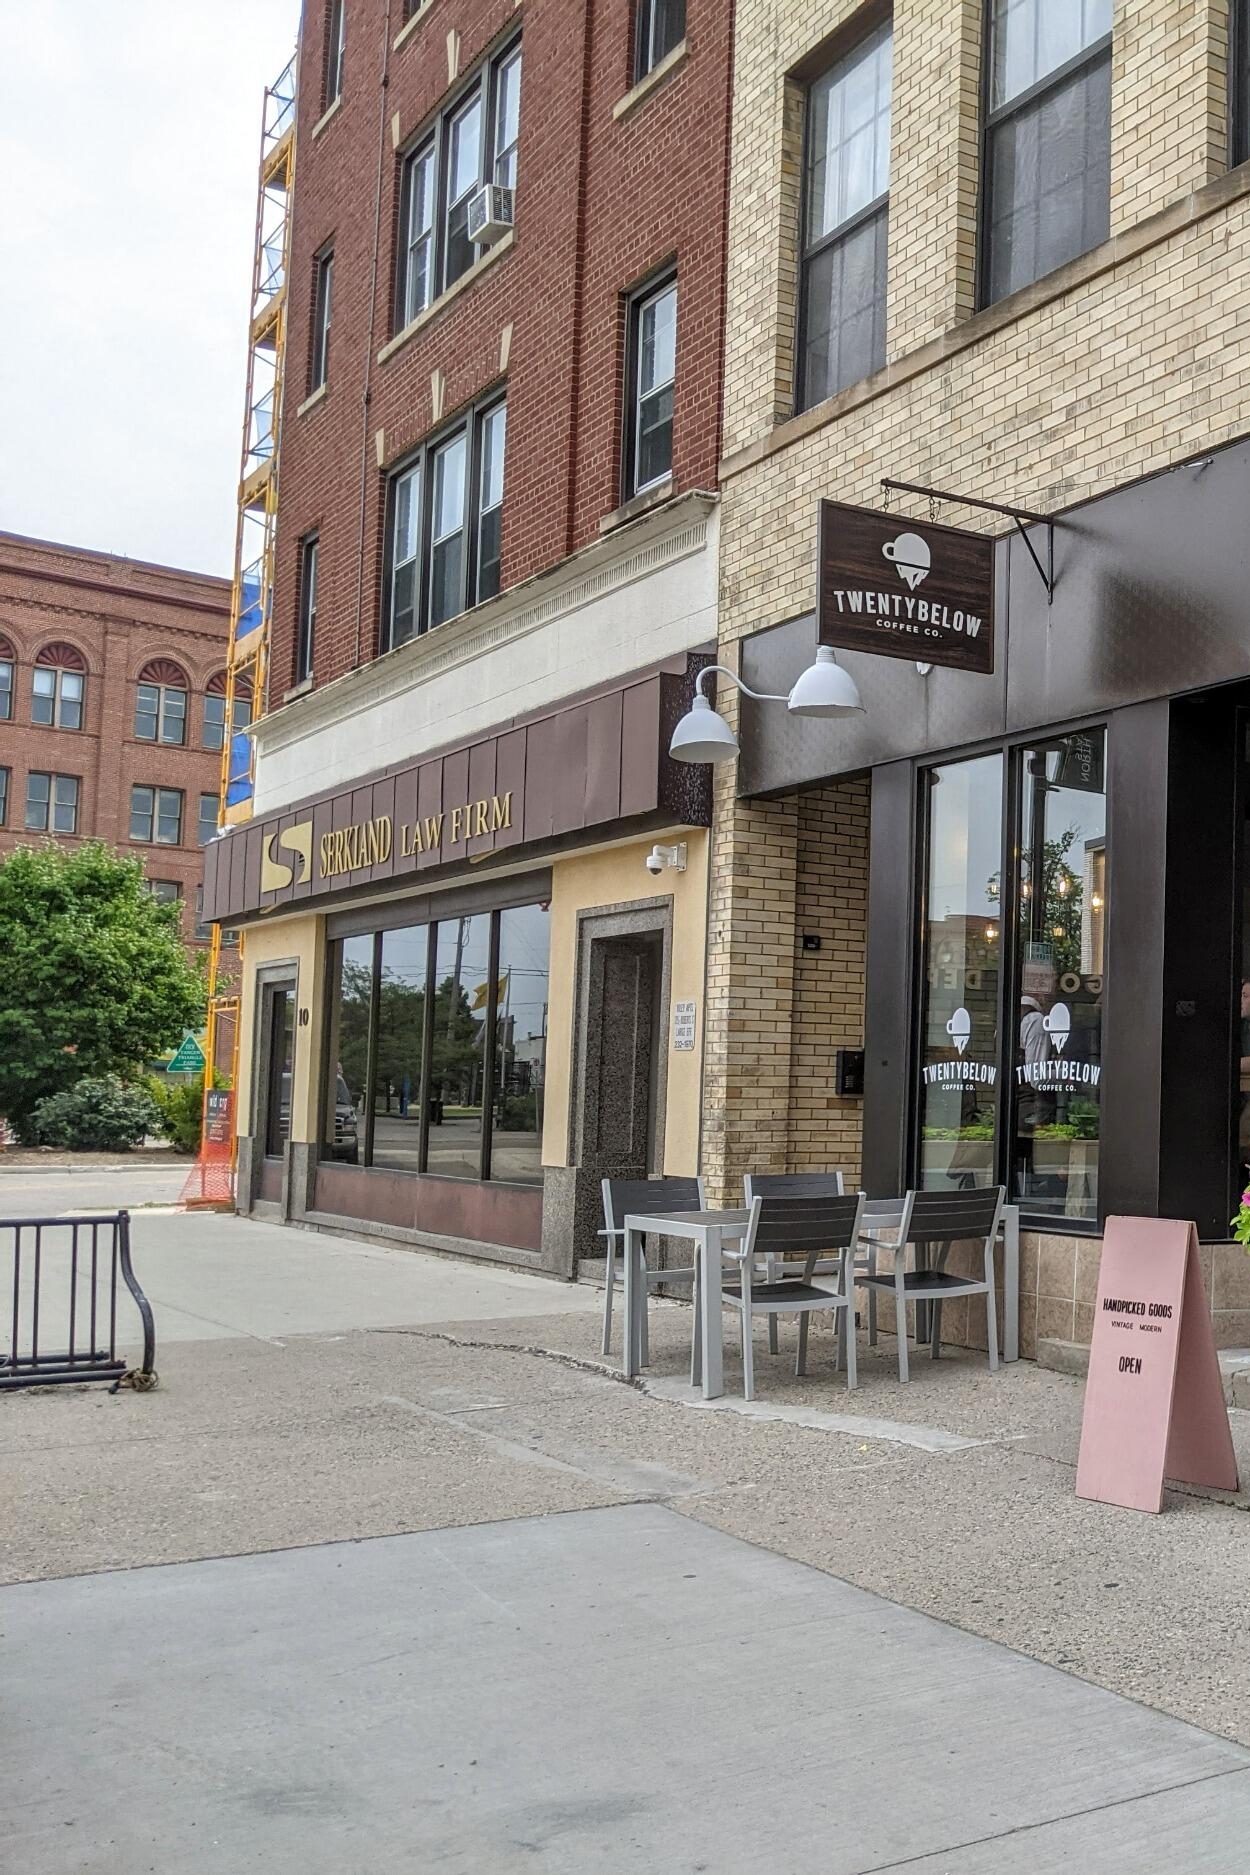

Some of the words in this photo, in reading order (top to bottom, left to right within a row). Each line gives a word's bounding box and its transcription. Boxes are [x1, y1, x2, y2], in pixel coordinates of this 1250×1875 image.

[833, 590, 982, 638] TWENTYBELOW
[876, 619, 919, 634] COFFEE
[924, 627, 943, 638] CO.
[319, 815, 393, 879] SERKLAND
[401, 813, 445, 858] LAW
[450, 791, 513, 844] FIRM
[922, 1061, 997, 1086] TWENTYBELOW
[1016, 1060, 1101, 1086] TWENTYBELOW
[941, 1083, 964, 1091] COFFEE
[1038, 1084, 1063, 1092] COFFEE
[1065, 1084, 1077, 1092] CO.
[1102, 1298, 1146, 1316] HANDPICKED
[1148, 1302, 1173, 1319] GOODS
[1111, 1320, 1134, 1330] VINTAGE
[1139, 1324, 1163, 1333] MODERN
[1118, 1356, 1142, 1375] OPEN
